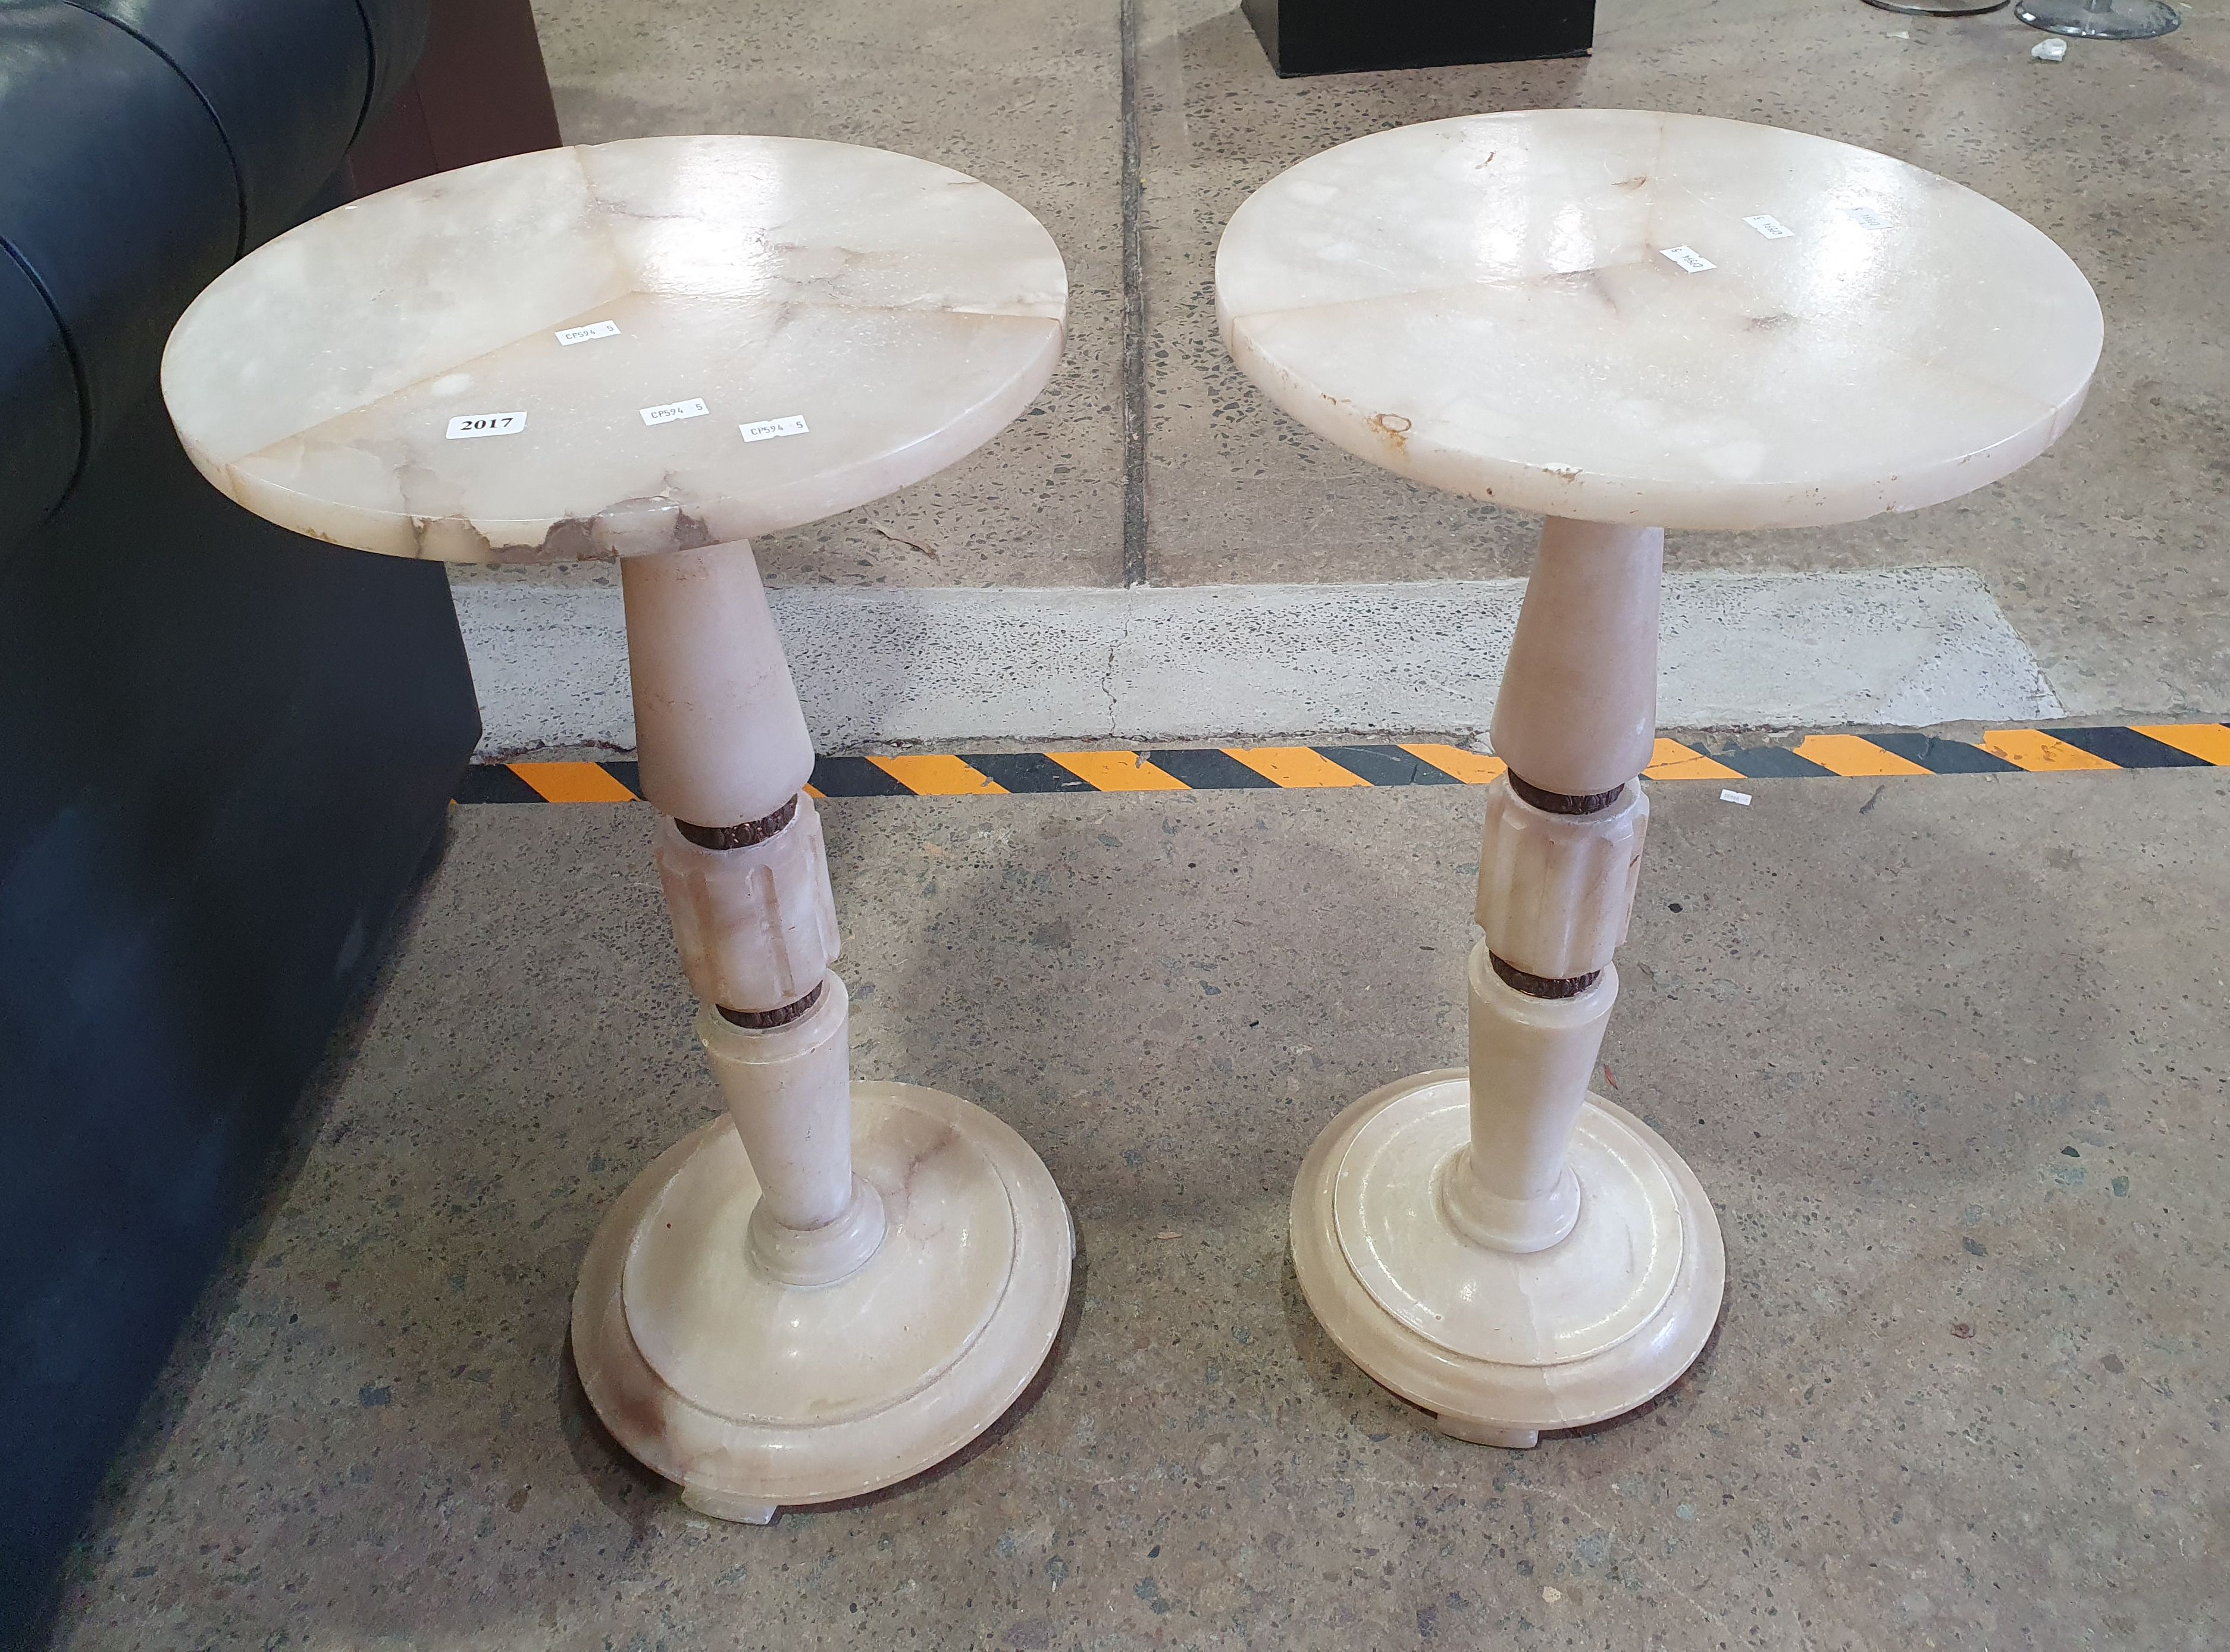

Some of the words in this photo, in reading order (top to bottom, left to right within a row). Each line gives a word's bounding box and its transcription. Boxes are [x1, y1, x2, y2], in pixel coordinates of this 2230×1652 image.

[565, 329, 596, 340] CP594
[650, 407, 684, 419] CP594
[459, 418, 513, 431] 2017
[750, 424, 784, 435] CP594
